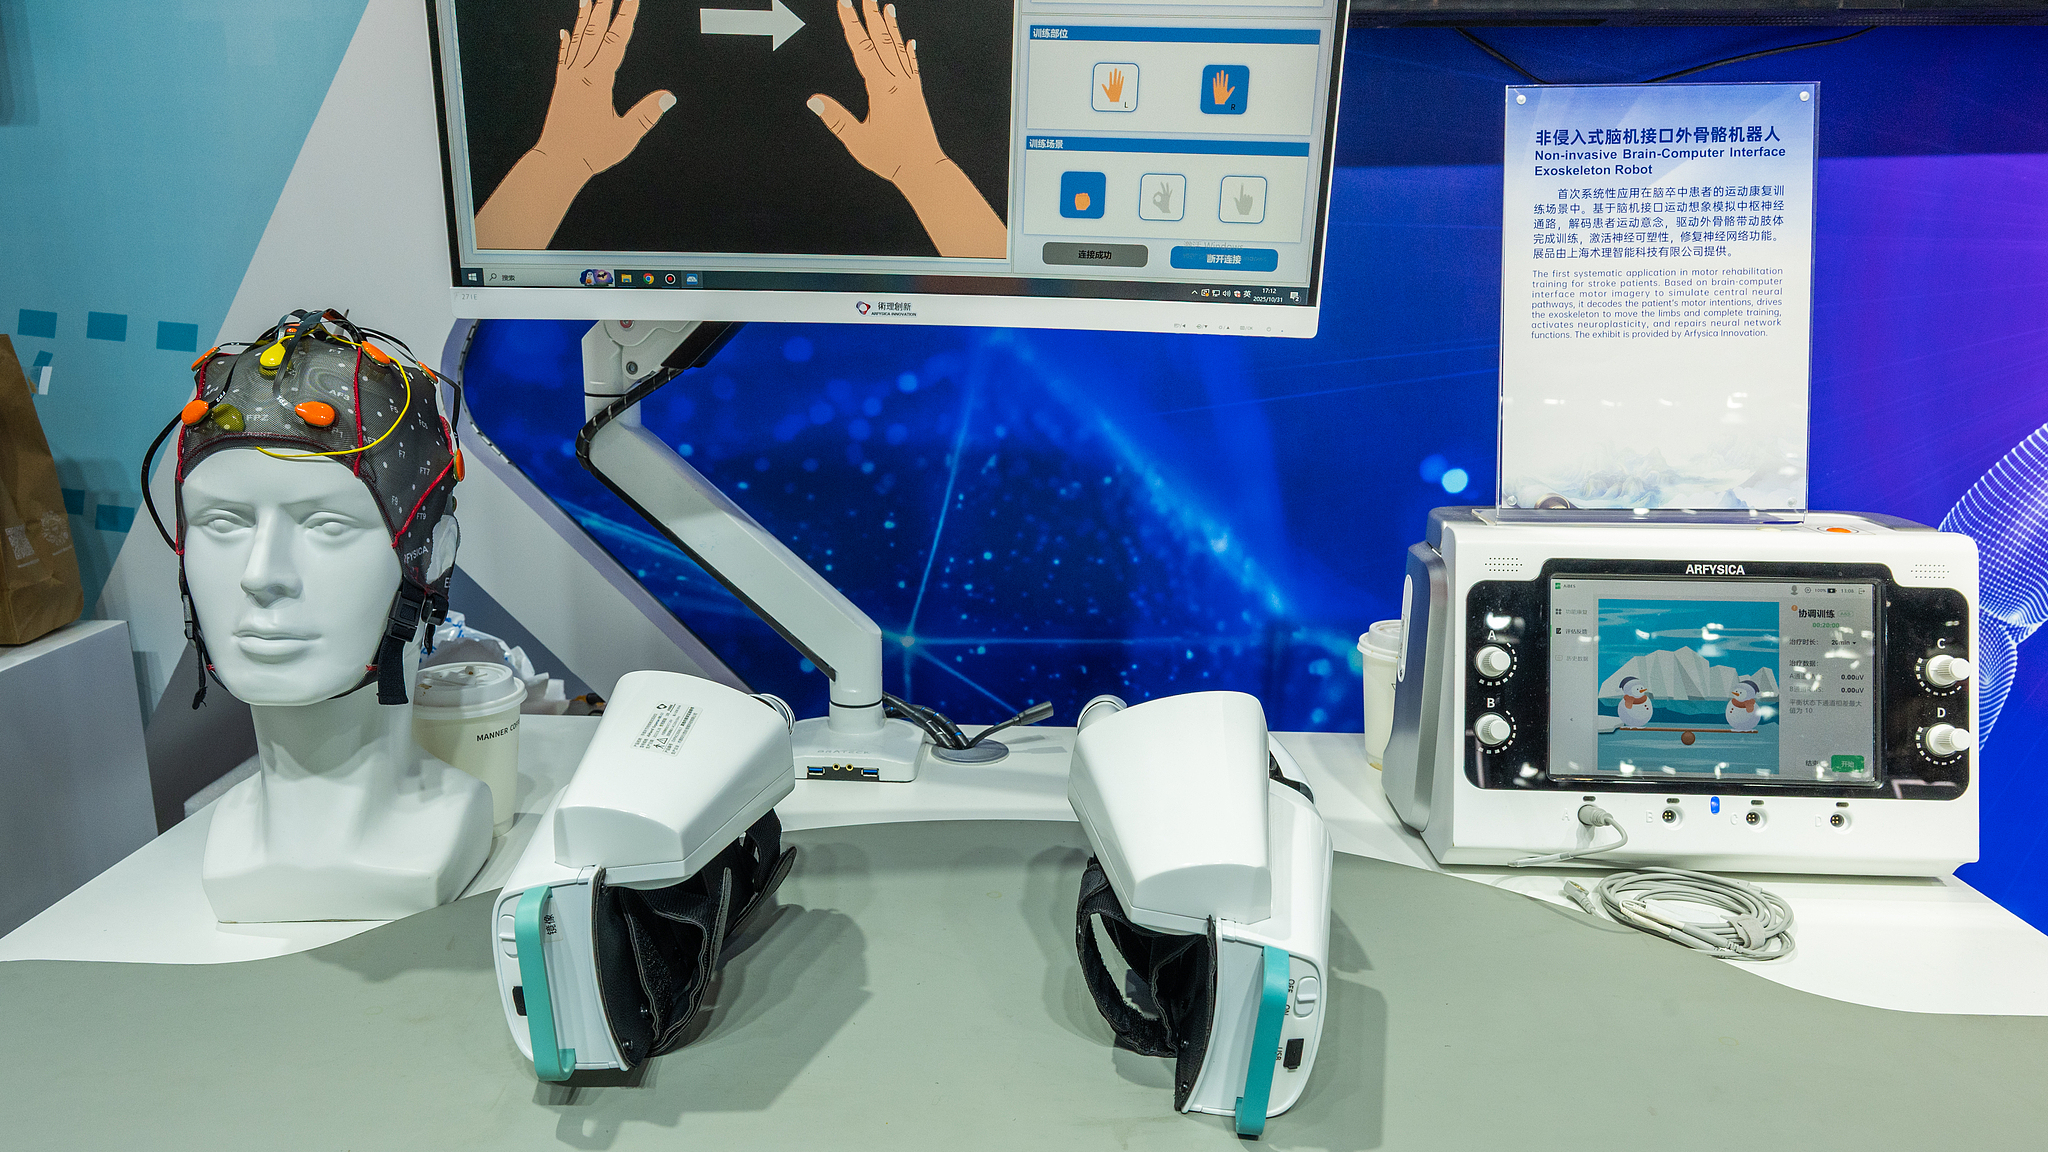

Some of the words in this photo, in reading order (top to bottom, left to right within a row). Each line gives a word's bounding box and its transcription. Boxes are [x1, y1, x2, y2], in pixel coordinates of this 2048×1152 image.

[1032, 27, 1068, 39] 训练部位
[1536, 126, 1780, 146] 非侵入式脑机接口外骨骼机器人
[1029, 139, 1064, 149] 训练场景
[1535, 150, 1617, 160] Non-invasive
[1623, 148, 1725, 159] Brain-Computer
[1730, 146, 1785, 157] Interface
[1535, 165, 1610, 176] Exoskeleton
[1615, 164, 1652, 174] Robot
[1558, 185, 1784, 199] 首次系统性应用在脑卒中患者的运动康复训
[1534, 200, 1784, 214] 练场景中。基于脑机接口运动想象模拟中枢神经
[1534, 215, 1784, 230] 通路，解码患者运动意念，驱动外骨骼带动肢体
[1534, 230, 1777, 245] 完成训练，激活神经可塑性，修复神经网络功能。
[1078, 250, 1112, 260] 连接成功
[1533, 245, 1731, 259] 展品由上海术理智能科技有限公司提供。
[1206, 254, 1241, 264] 断开连接
[1574, 269, 1622, 279] systematic
[1626, 269, 1676, 278] application
[1722, 267, 1783, 275] rehabilitation
[1533, 281, 1567, 291] training
[1620, 279, 1660, 288] patients.
[1712, 278, 1782, 286] brain-computer
[1612, 290, 1650, 299] imagery
[1714, 288, 1747, 296] central
[1532, 301, 1575, 310] pathways,
[1579, 300, 1583, 308] it
[1642, 299, 1678, 308] patient's
[1710, 299, 1753, 307] intentions,
[1659, 309, 1680, 317] limbs
[1684, 309, 1700, 317] and
[1704, 309, 1743, 318] complete
[1747, 308, 1781, 317] training,
[1578, 320, 1649, 329] neuroplasticity,
[1675, 320, 1706, 328] repairs
[1744, 318, 1781, 326] network
[1532, 331, 1572, 339] functions.
[1592, 330, 1620, 338] exhibit
[1632, 330, 1669, 339] provided
[1672, 330, 1682, 339] by
[1684, 329, 1718, 339] Arfysica
[399, 450, 406, 459] F7
[1685, 564, 1745, 575] ARFYSICA
[1798, 609, 1835, 618] 协调训练
[1487, 630, 1497, 640] A
[1937, 638, 1946, 649] C
[1487, 697, 1495, 708] B
[1937, 707, 1946, 718] D
[477, 727, 508, 741] MANNER
[1562, 808, 1570, 822] A
[1646, 811, 1653, 823] B
[1730, 812, 1738, 825] C
[1815, 816, 1822, 827] D
